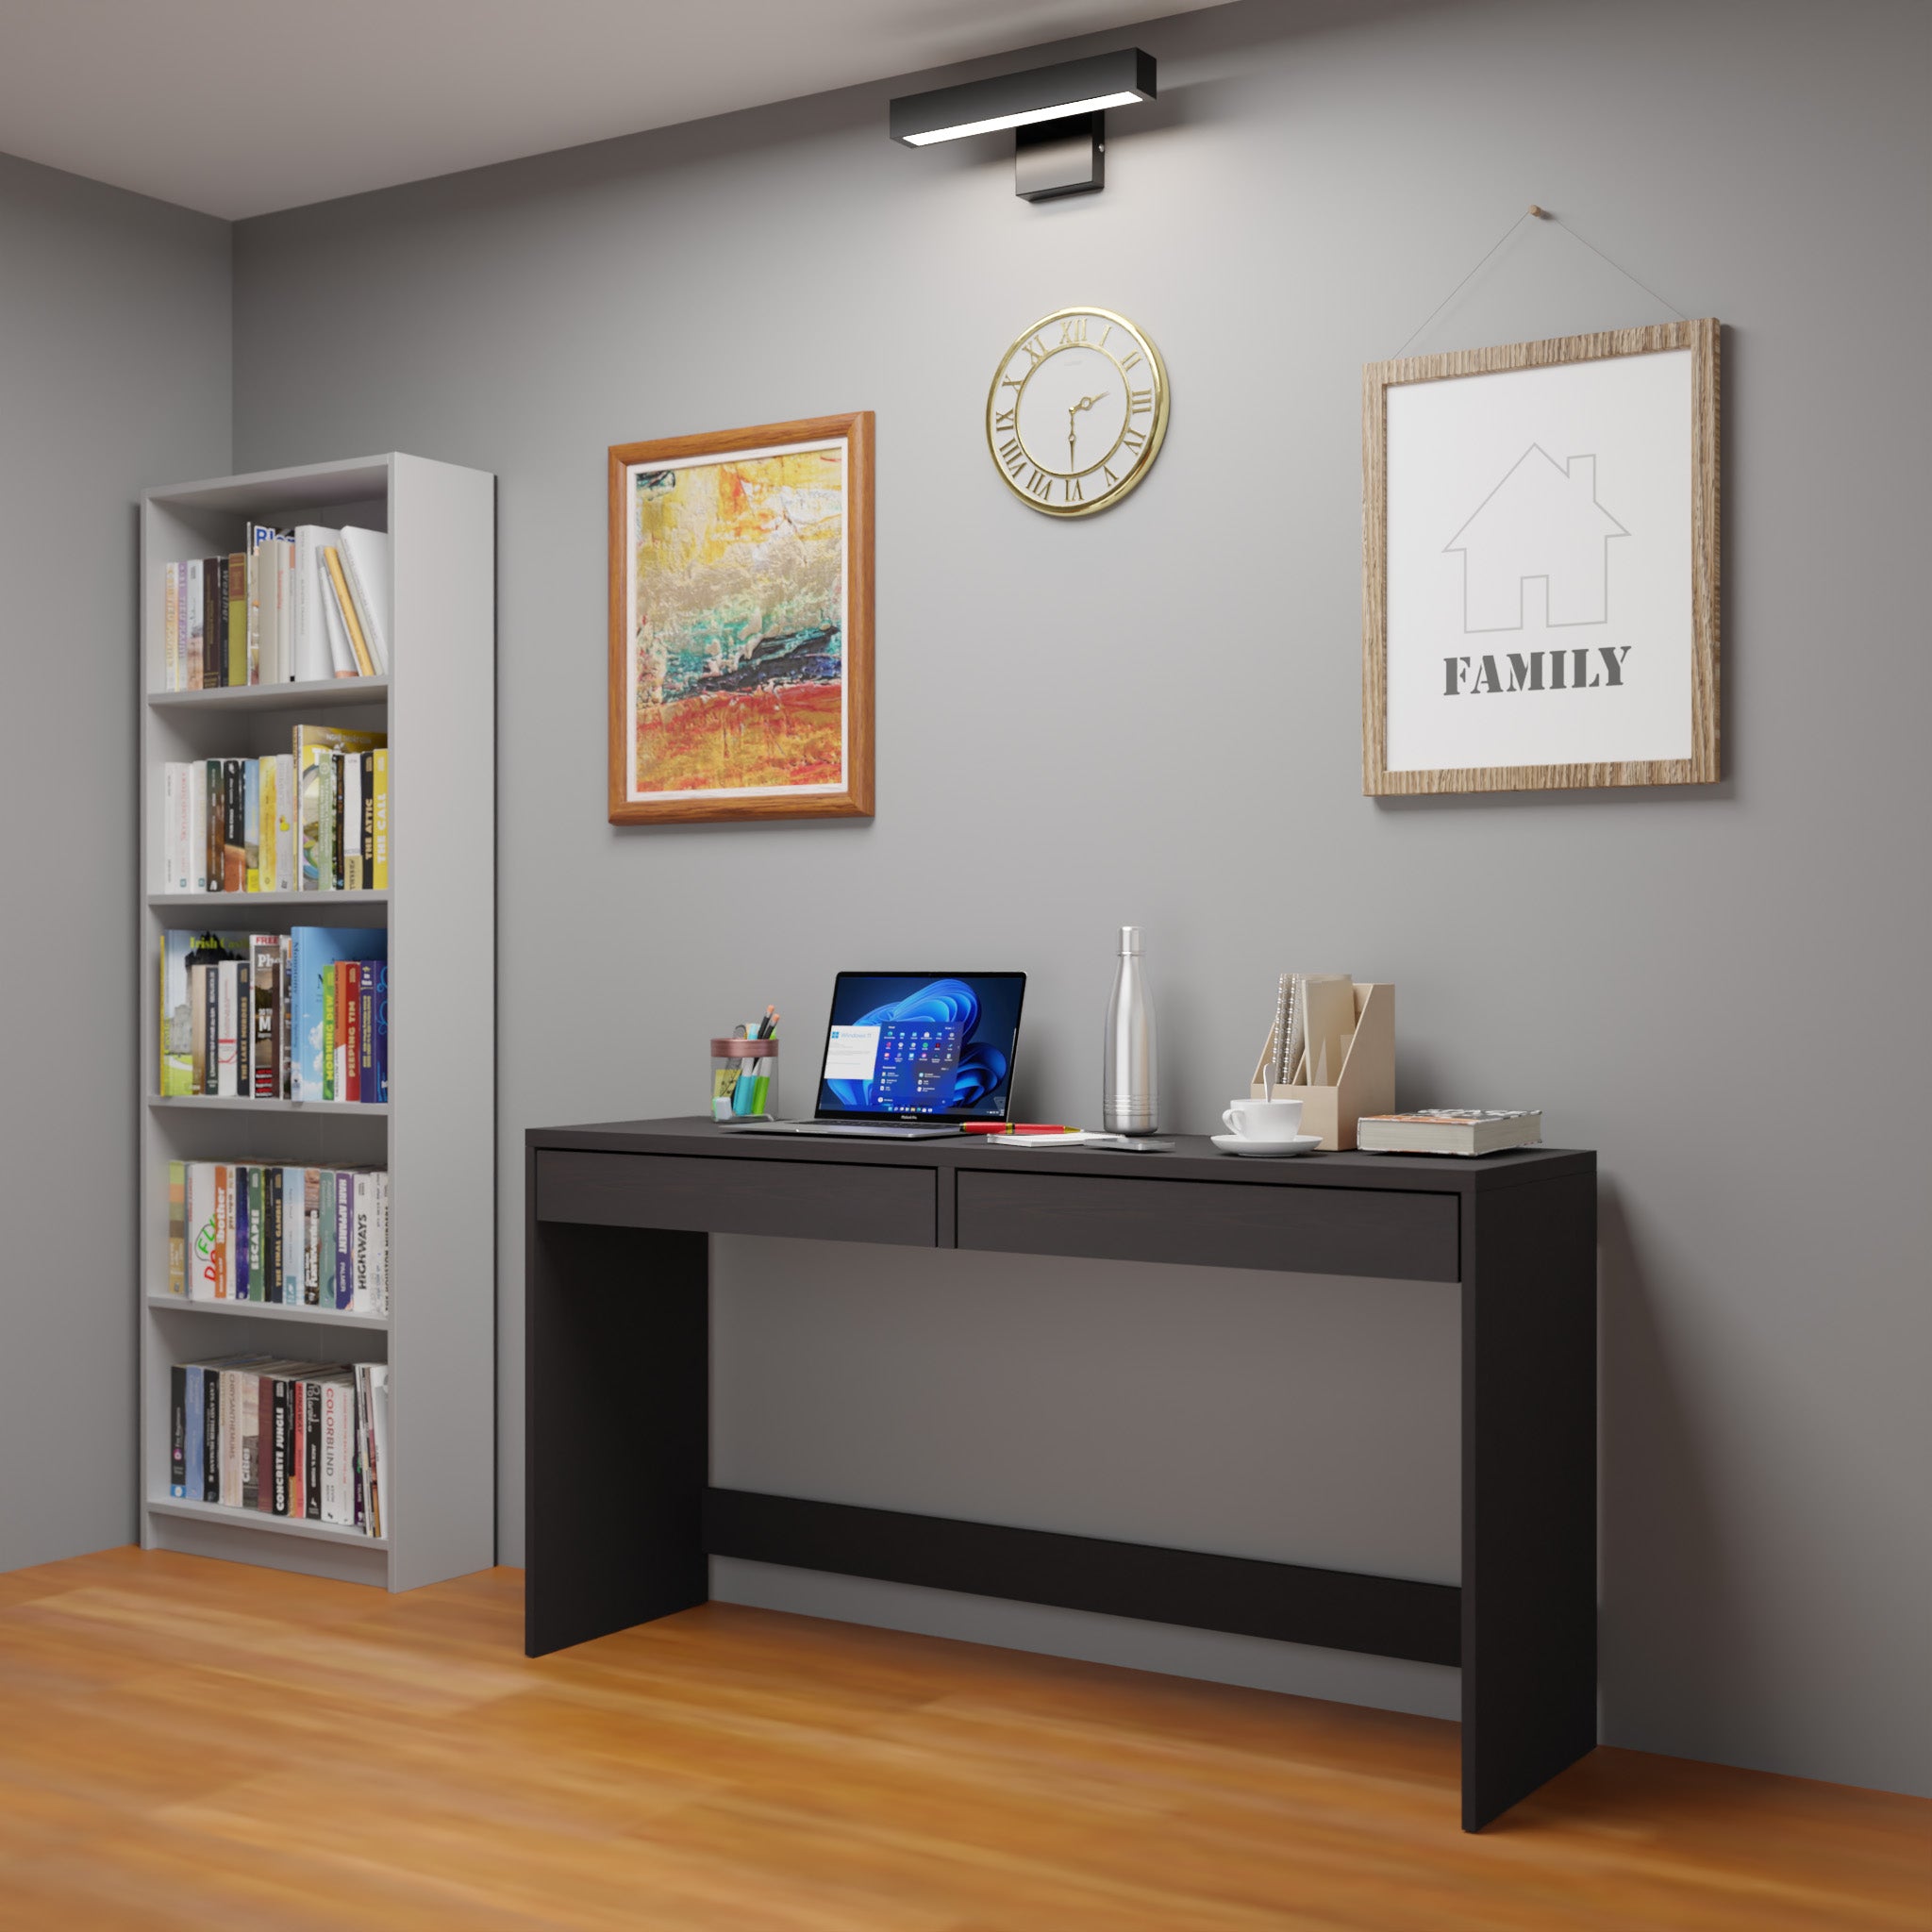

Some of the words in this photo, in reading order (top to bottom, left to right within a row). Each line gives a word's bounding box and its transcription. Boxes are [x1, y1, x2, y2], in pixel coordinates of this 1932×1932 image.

[1059, 319, 1087, 344] XII
[1099, 325, 1111, 346] I
[1023, 336, 1048, 365] XI
[1120, 349, 1141, 372] II
[1002, 375, 1024, 393] X
[1132, 389, 1152, 414] III
[996, 408, 1014, 432] IX
[1123, 427, 1146, 456] IV
[999, 437, 1027, 478] VIII
[1025, 469, 1053, 501] VII
[1065, 478, 1084, 502] VI
[1103, 464, 1120, 487] V
[1443, 645, 1632, 696] FAMILY
[377, 793, 386, 830] CALL
[377, 834, 386, 863] THE
[190, 936, 217, 949] Irish
[339, 1179, 347, 1205] HARE
[251, 1209, 259, 1270] ESCAPEE
[339, 1206, 347, 1254] APPARENT
[358, 1214, 367, 1290] HIGHWAYS
[325, 1388, 334, 1476] COLORBLIND
[275, 1452, 284, 1511] CONCRETE
